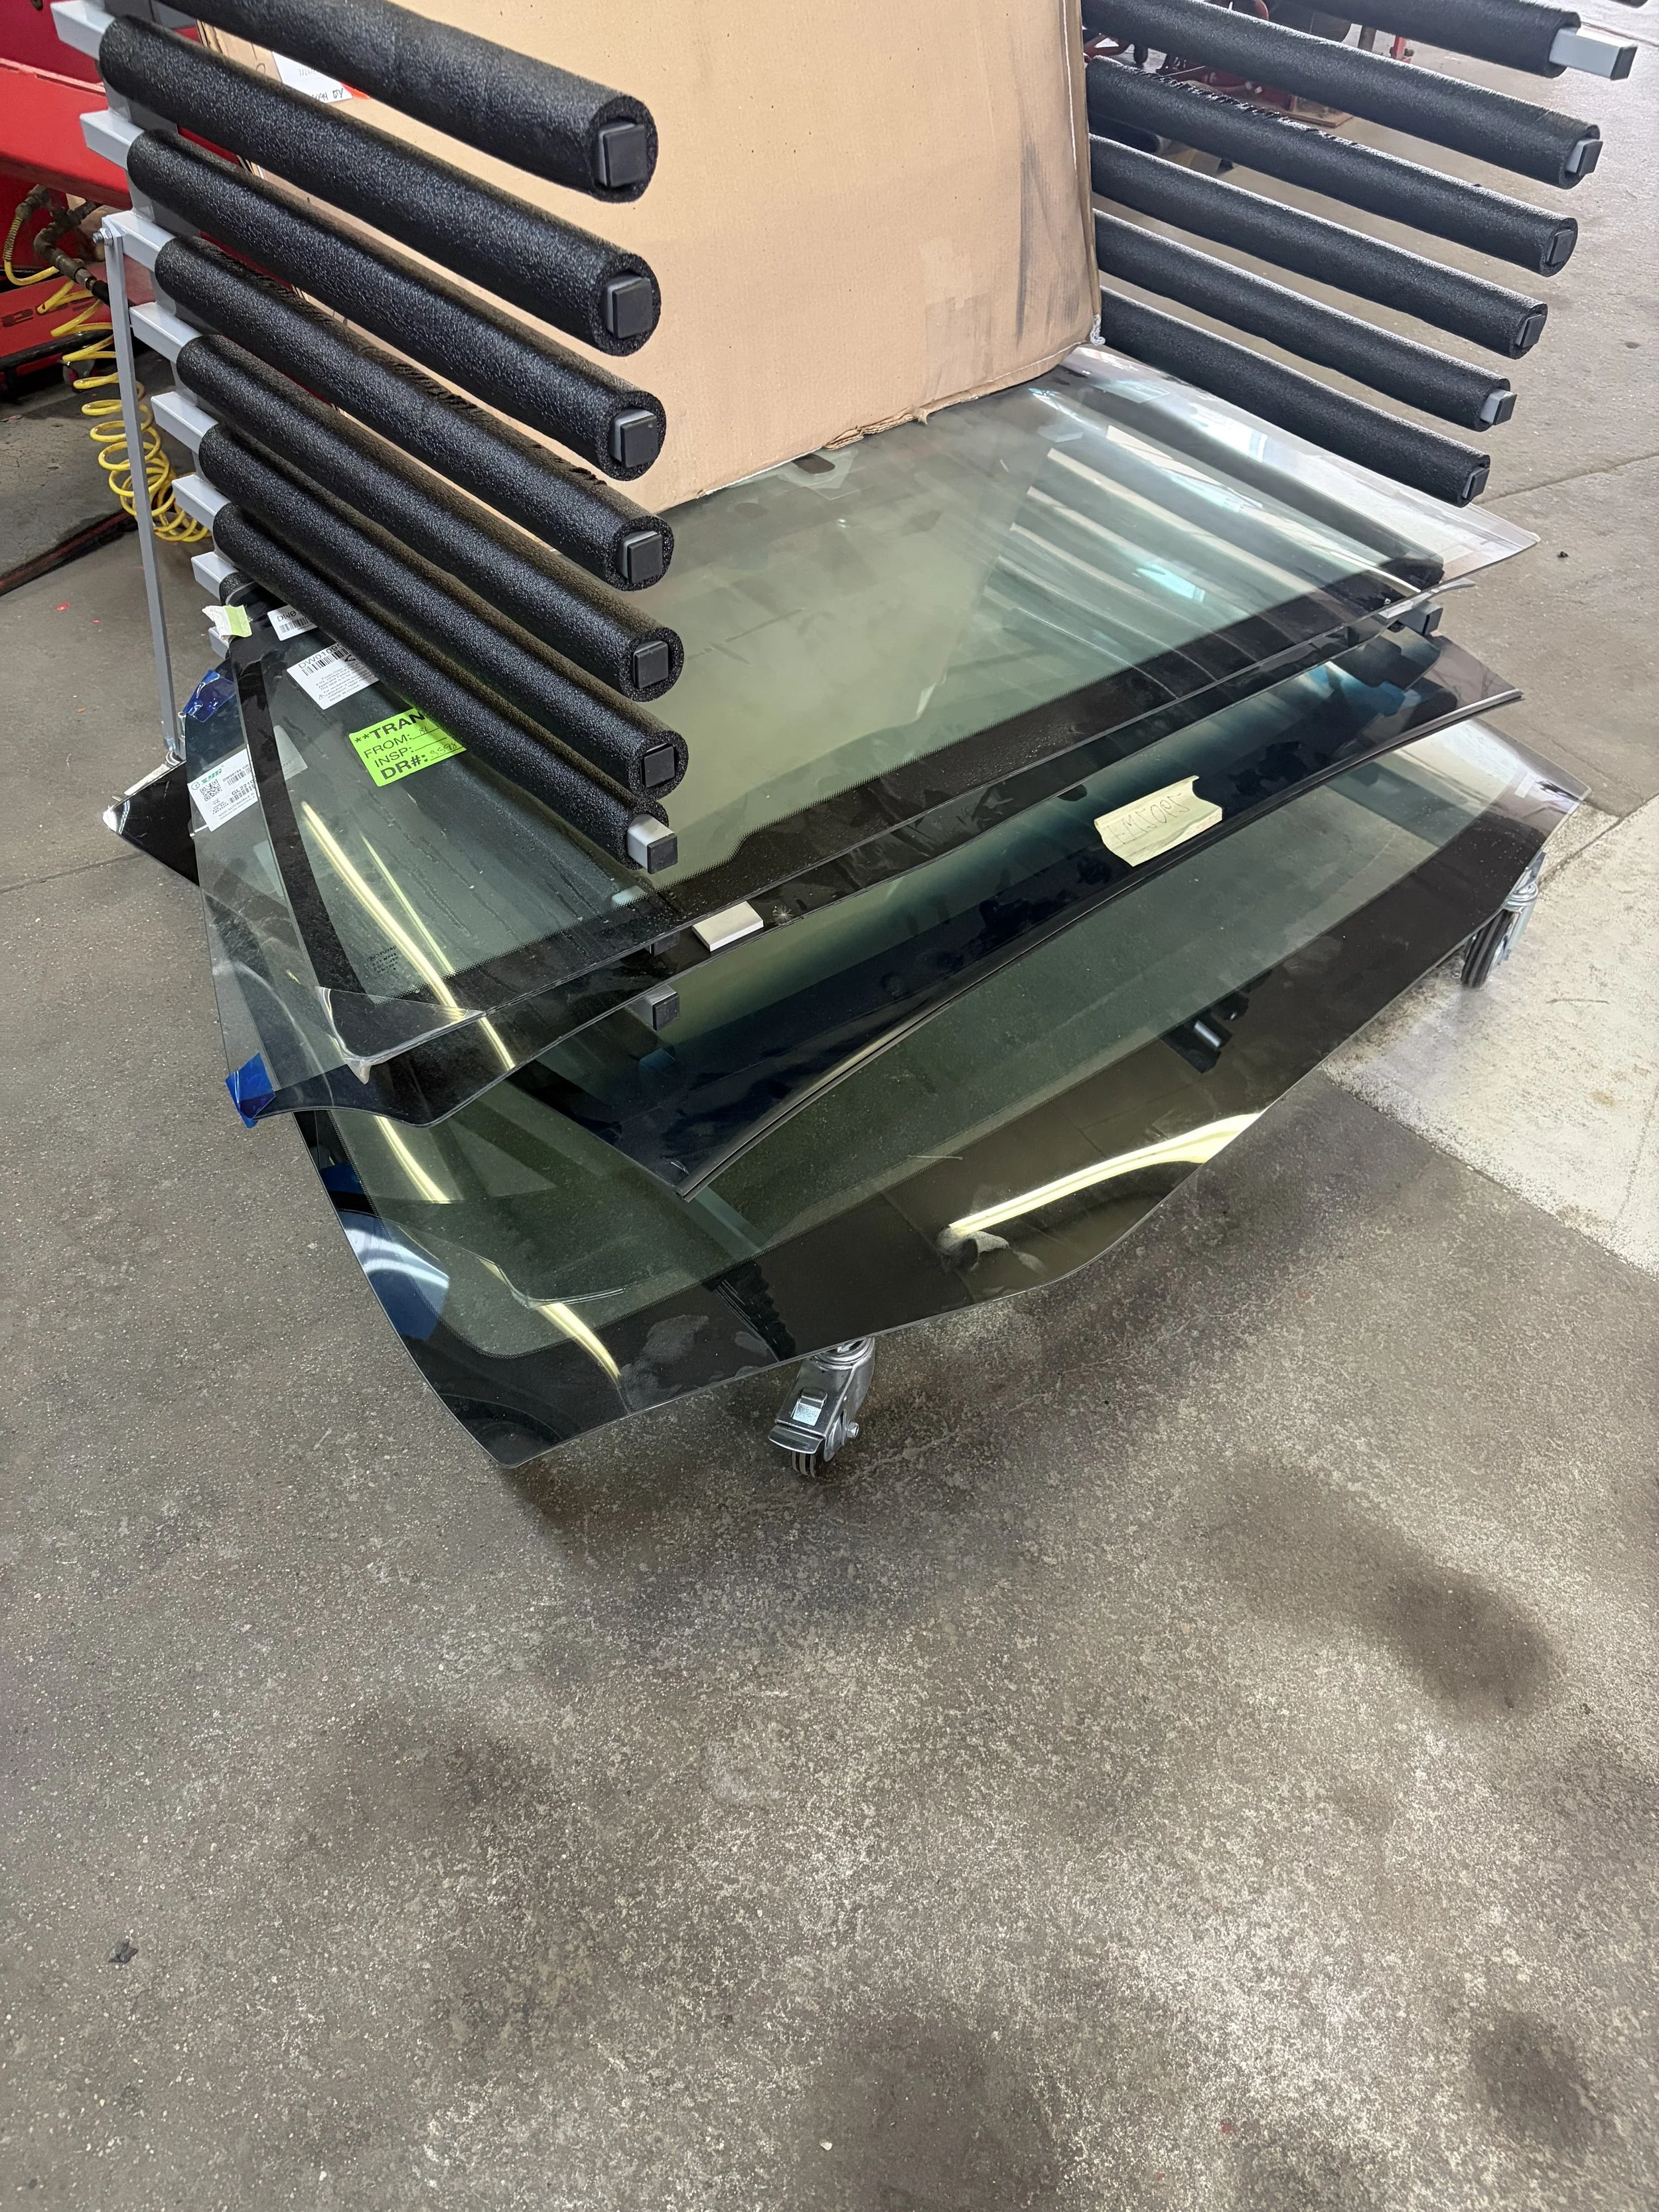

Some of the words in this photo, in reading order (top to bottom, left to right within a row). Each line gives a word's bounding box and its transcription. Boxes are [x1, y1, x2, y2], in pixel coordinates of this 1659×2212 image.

[364, 734, 411, 759] FROM:
[374, 747, 415, 768] INSP:
[380, 755, 429, 780] DR#:
